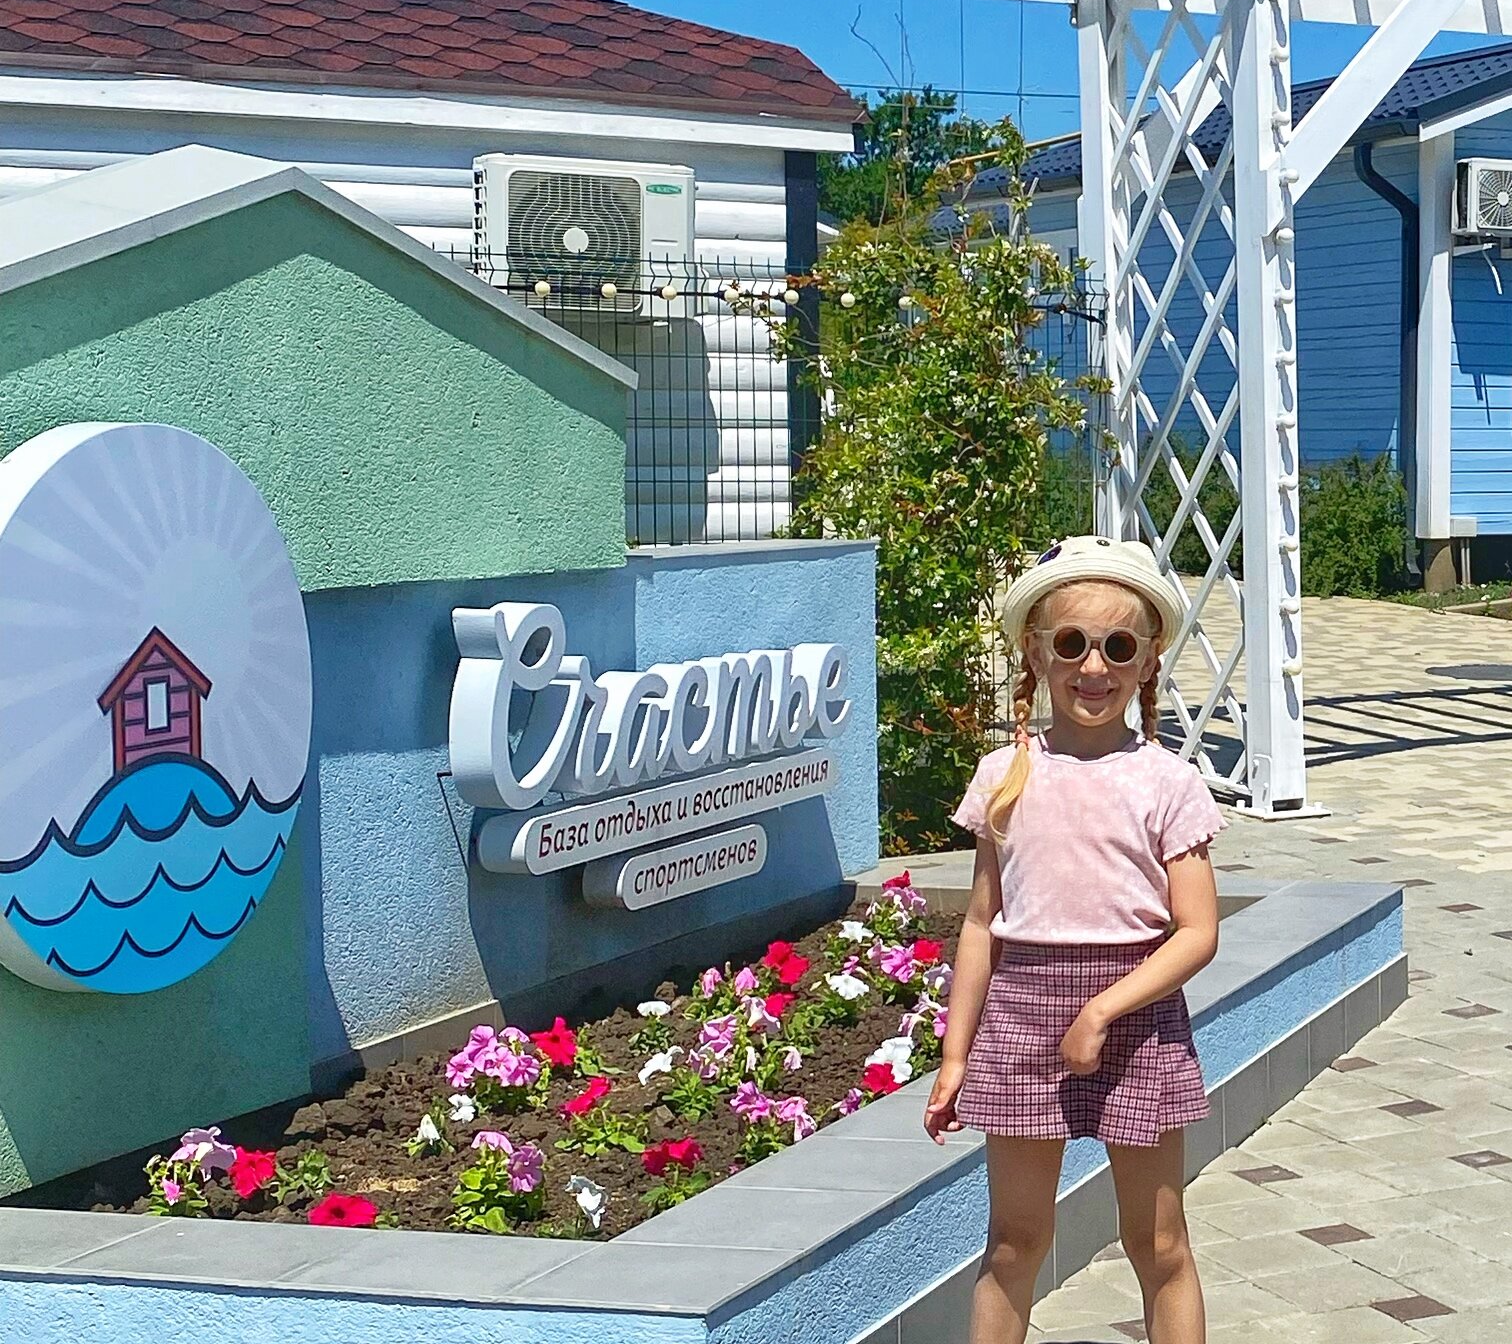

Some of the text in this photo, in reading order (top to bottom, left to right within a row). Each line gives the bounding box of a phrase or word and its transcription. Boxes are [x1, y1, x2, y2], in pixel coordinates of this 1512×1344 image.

[449, 602, 852, 810] Счастье
[538, 758, 829, 858] База отдыха и восстановления
[634, 838, 758, 895] спортсменов
